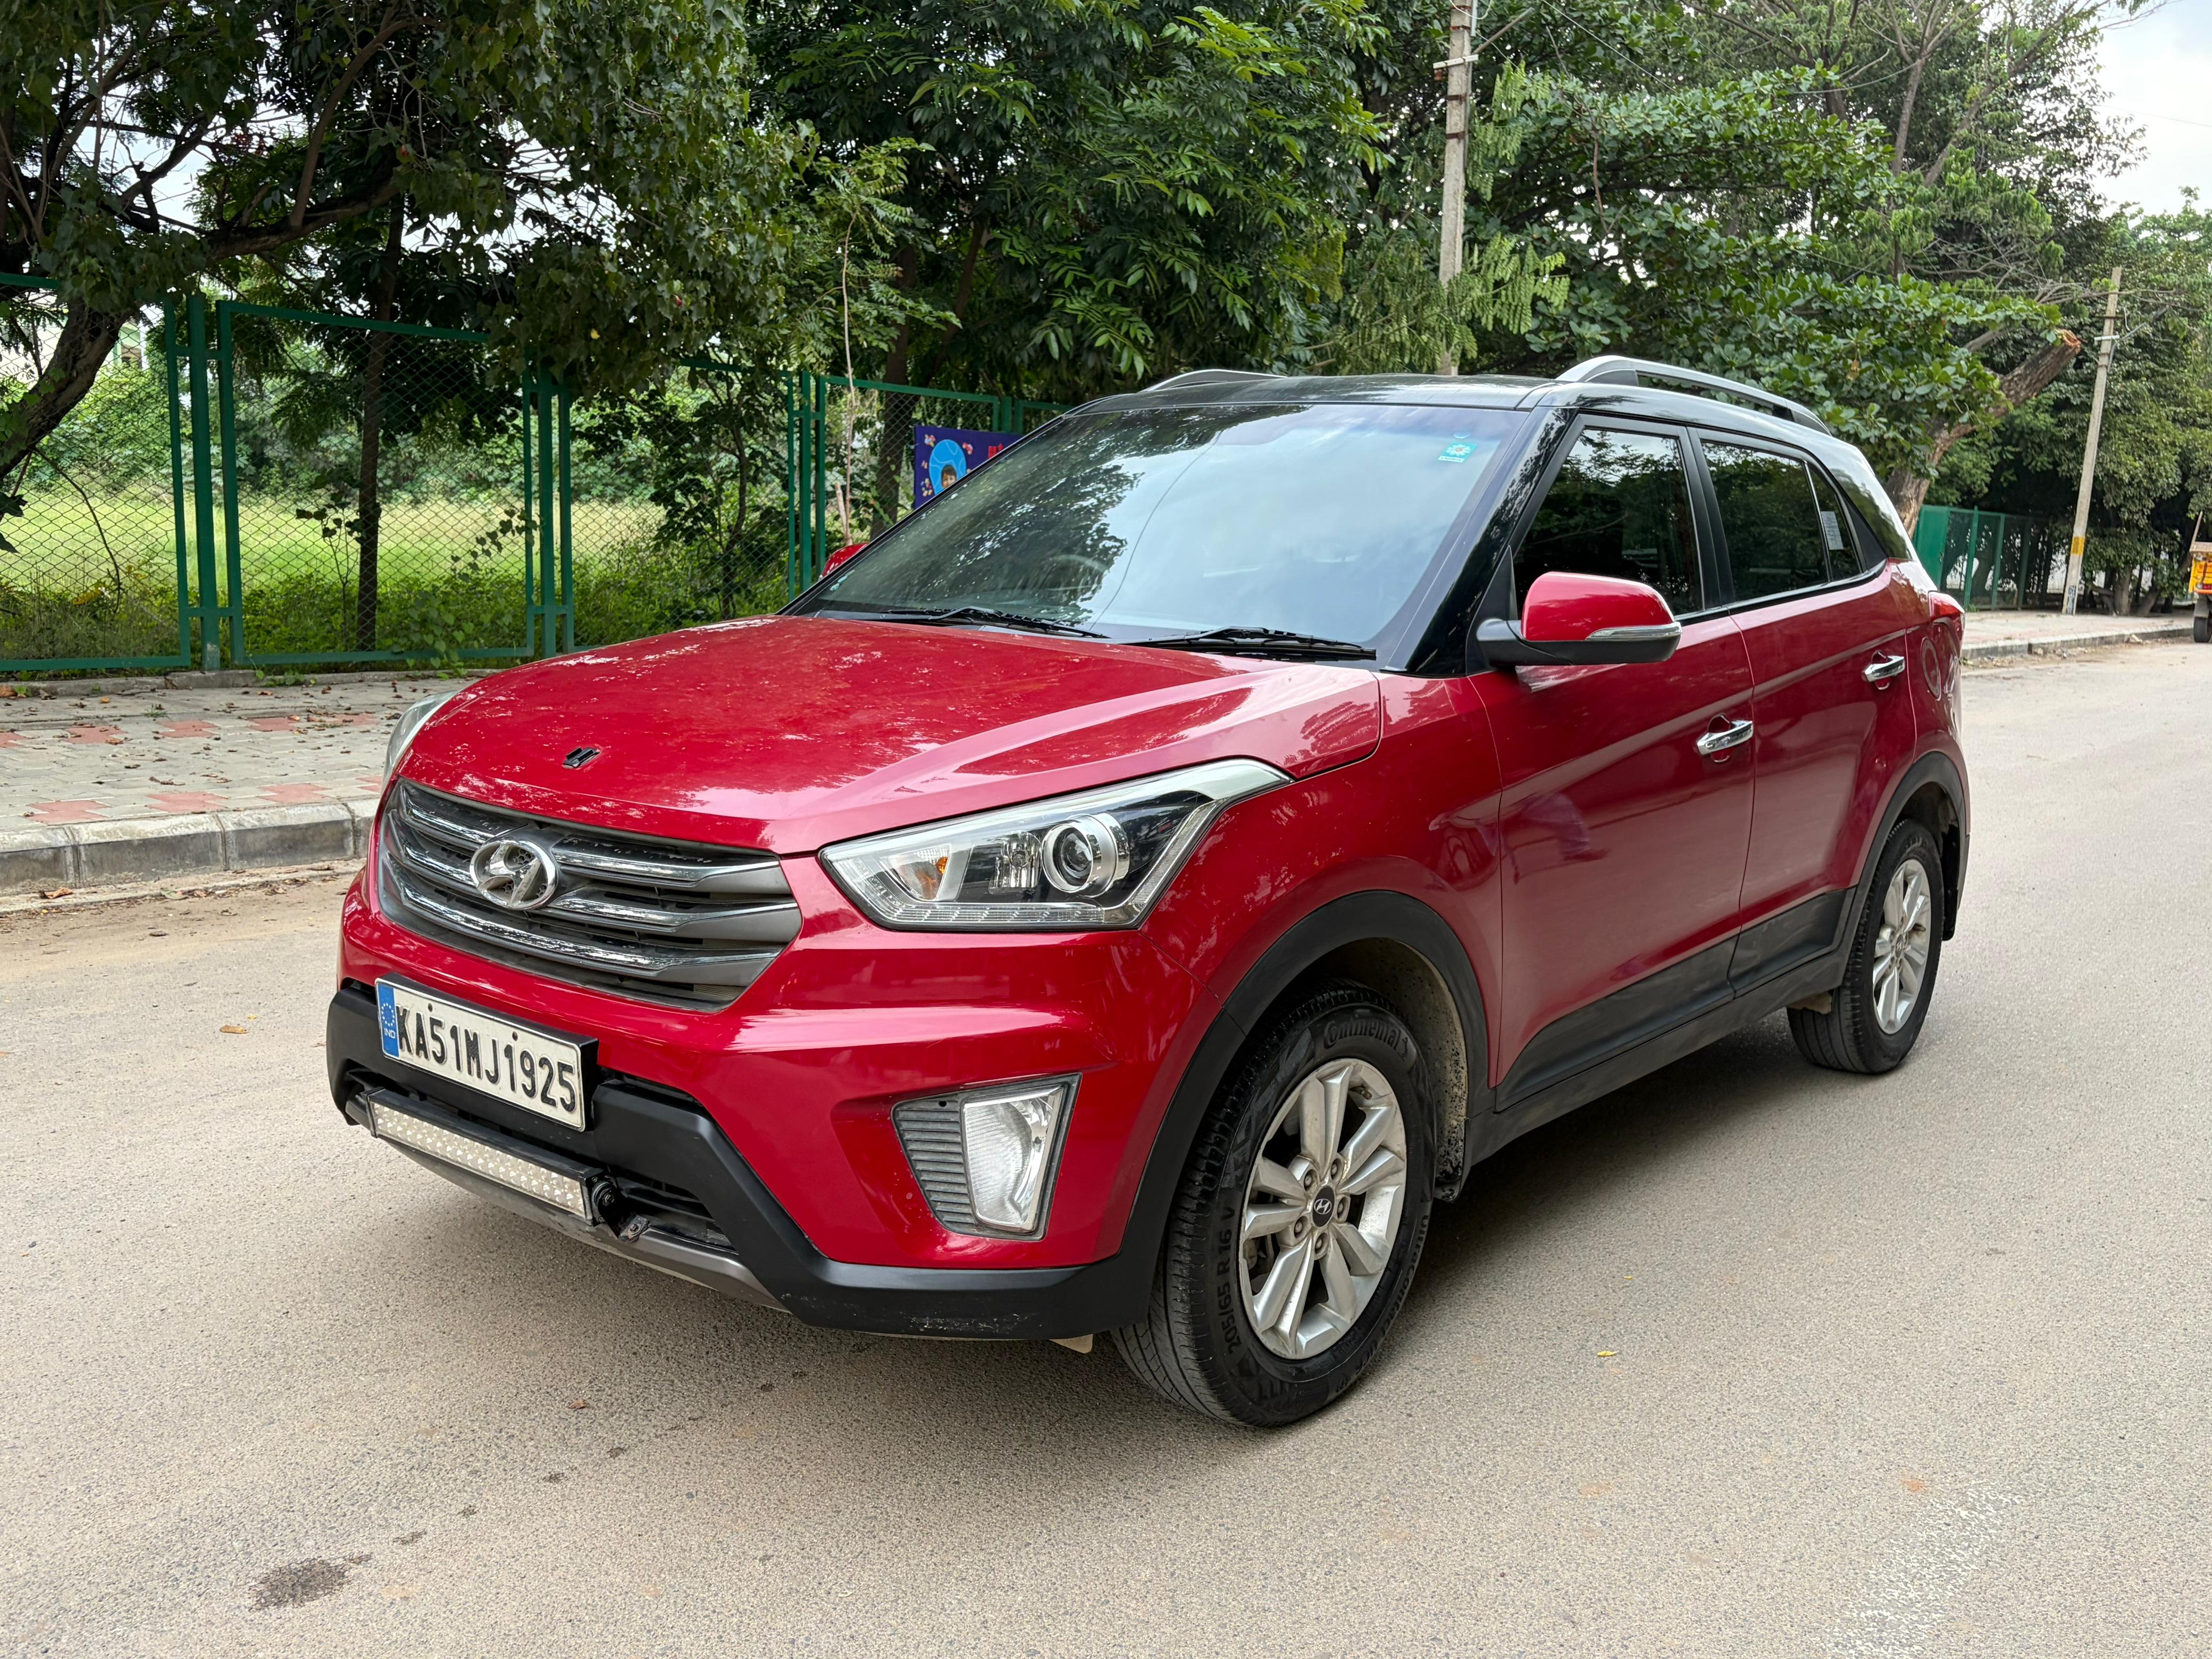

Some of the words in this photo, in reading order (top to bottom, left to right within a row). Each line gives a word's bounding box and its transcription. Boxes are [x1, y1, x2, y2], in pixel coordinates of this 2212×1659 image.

[384, 1028, 396, 1039] IND
[1323, 1017, 1402, 1051] Continental
[396, 1005, 576, 1113] KA51MJ1925
[1222, 1206, 1235, 1221] V
[1218, 1229, 1233, 1254] 16
[1217, 1258, 1230, 1275] R
[1382, 1215, 1429, 1337] UltraContact
[1217, 1281, 1242, 1354] 205/65
